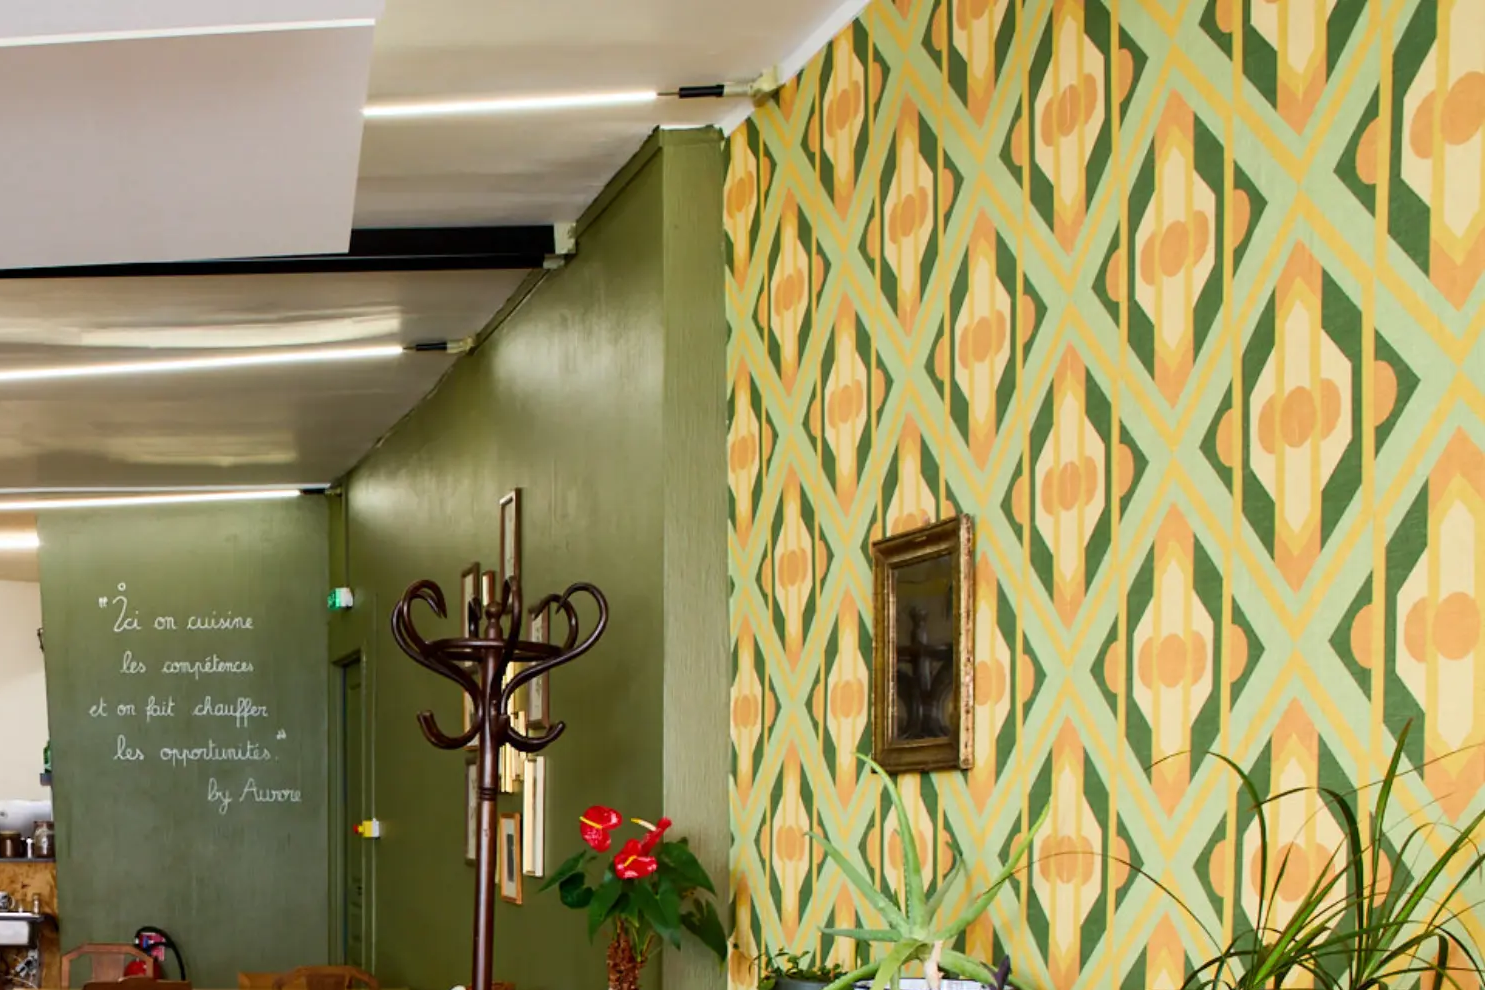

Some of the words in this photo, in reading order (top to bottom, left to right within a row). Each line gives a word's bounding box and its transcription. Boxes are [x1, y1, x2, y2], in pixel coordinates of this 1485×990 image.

[153, 616, 178, 630] on
[186, 610, 254, 630] cuisine
[120, 650, 147, 674] les
[161, 652, 254, 680] compétences
[88, 698, 108, 717] et
[117, 702, 136, 717] on
[146, 697, 175, 722] fait
[192, 696, 268, 728] chauffer
[113, 734, 145, 761] les
[207, 777, 234, 815] by
[239, 777, 302, 802] Aurore
